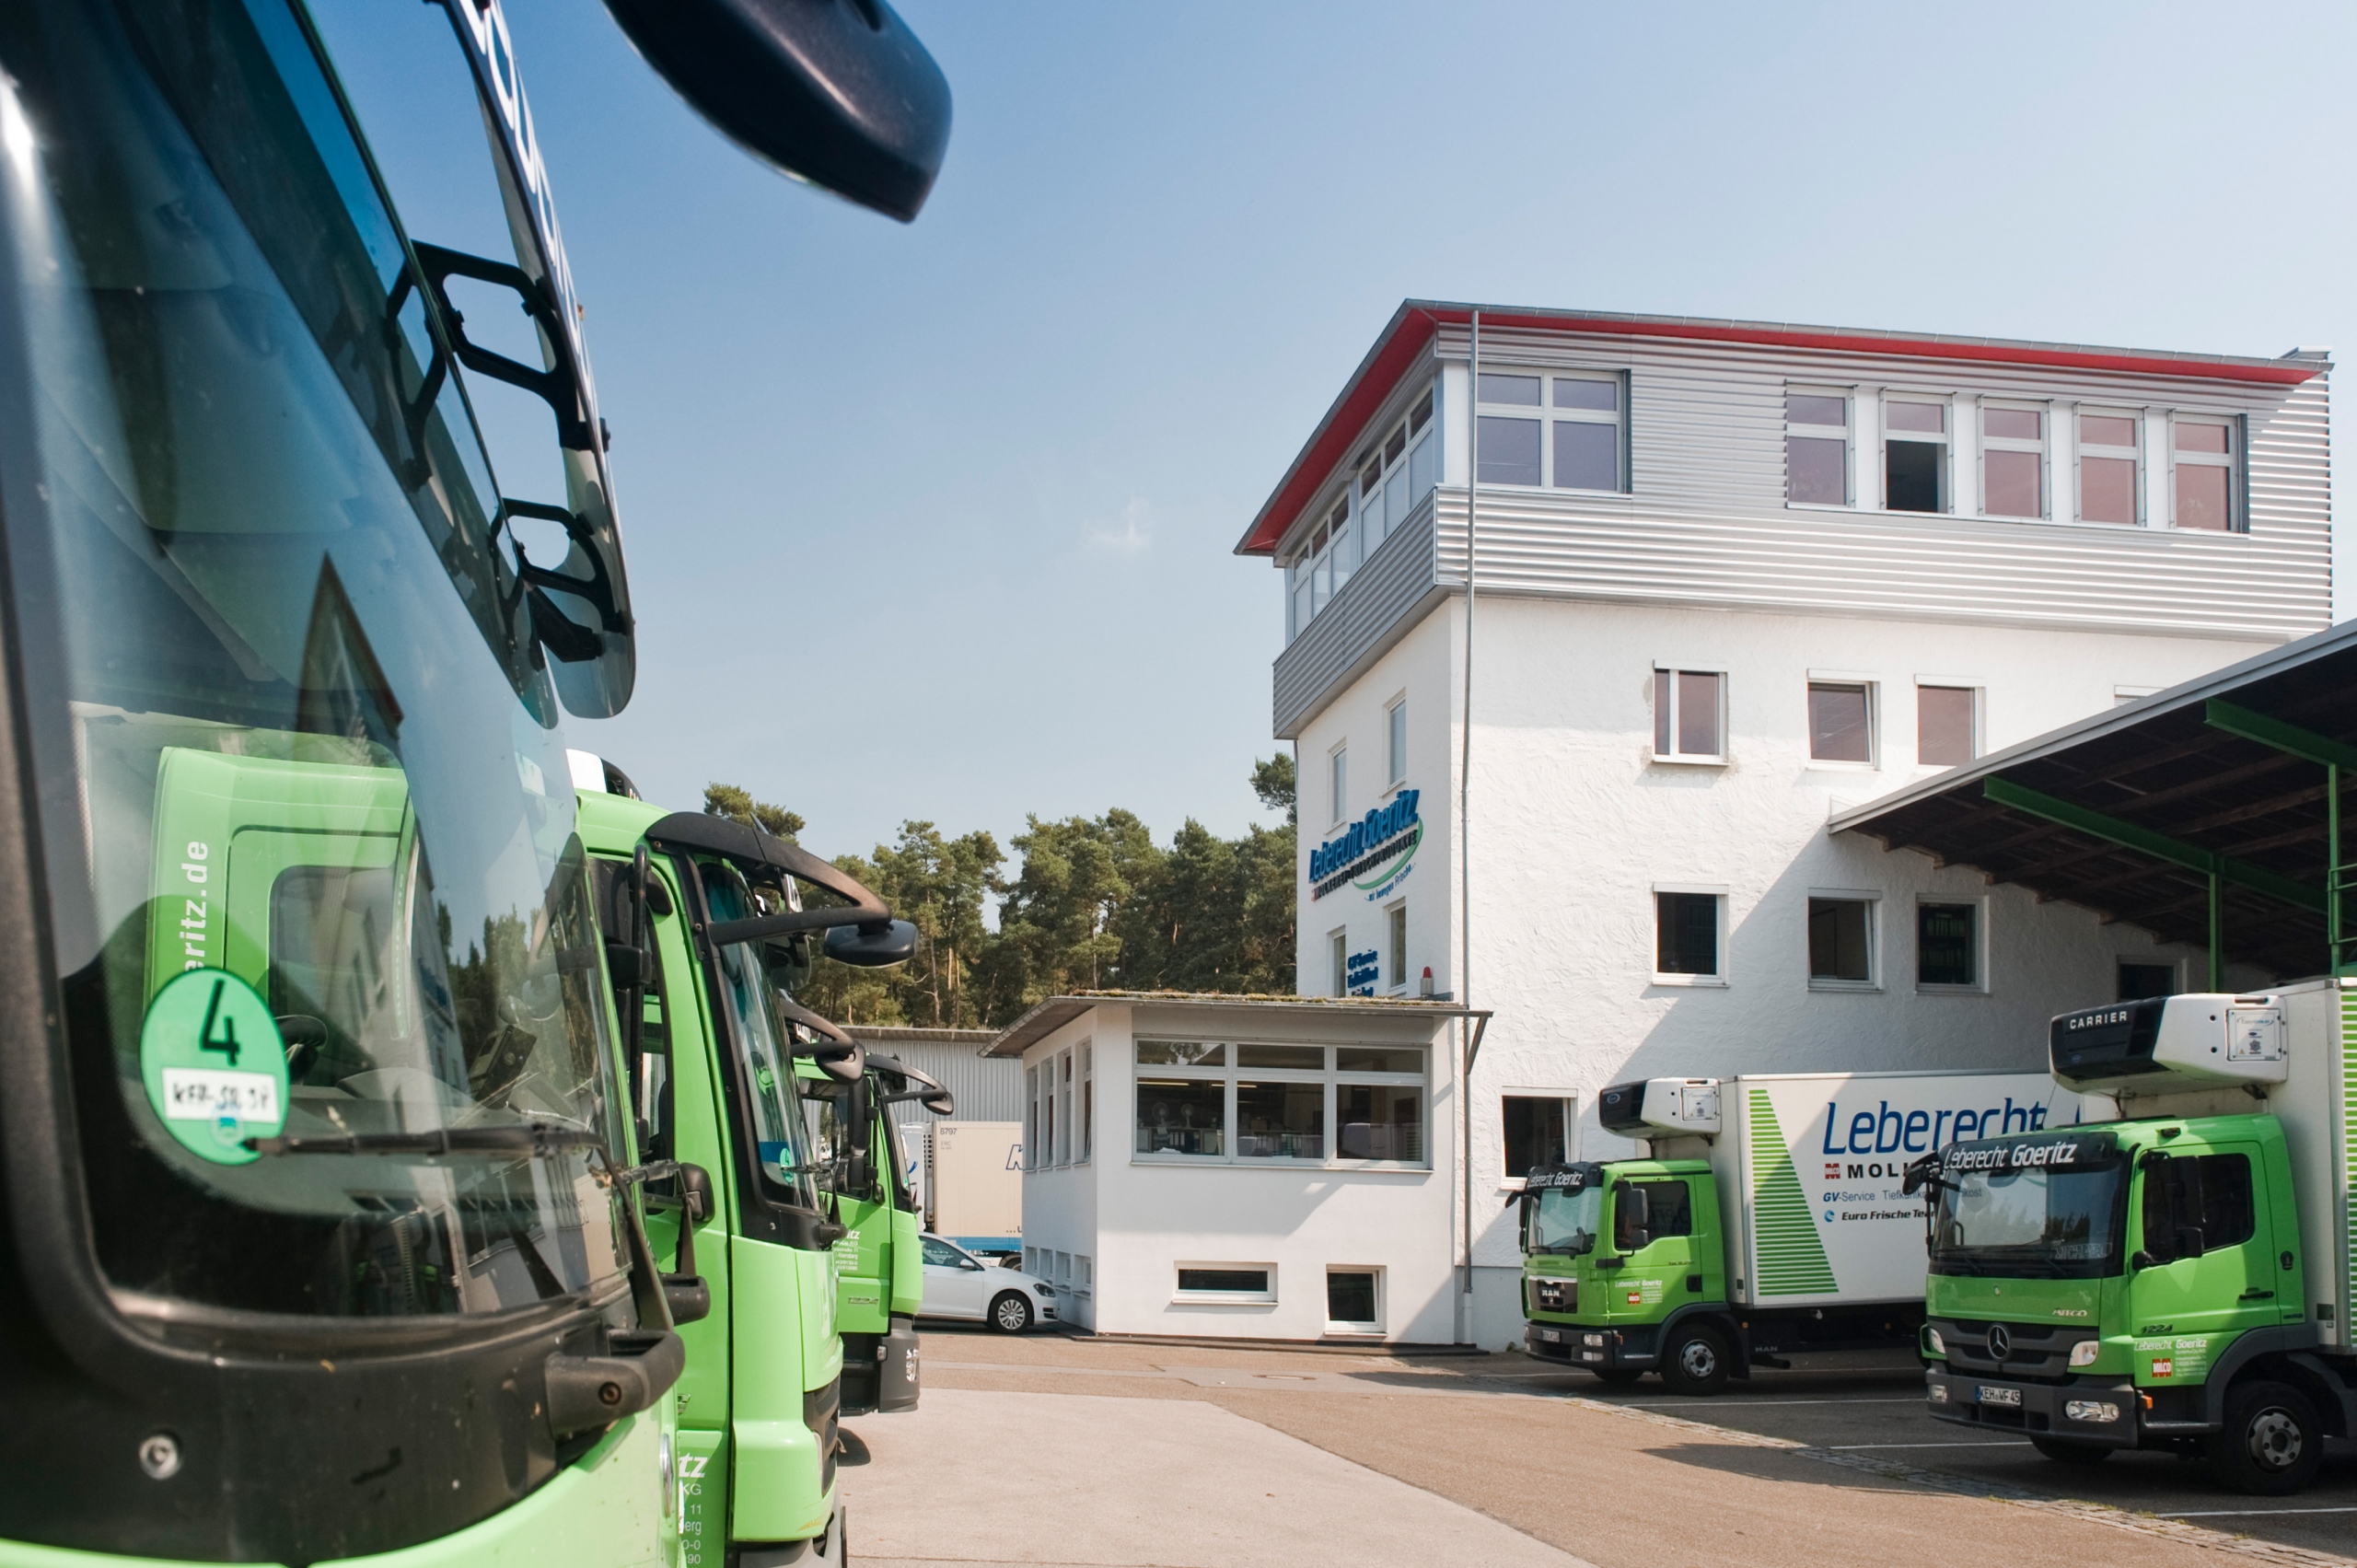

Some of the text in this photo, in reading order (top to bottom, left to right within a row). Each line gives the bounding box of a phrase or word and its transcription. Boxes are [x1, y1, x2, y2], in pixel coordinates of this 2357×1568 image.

[1308, 789, 1420, 883] Leberecht Goeritz
[199, 978, 240, 1066] 4
[2070, 1011, 2128, 1030] CARRIER
[939, 1127, 958, 1135] 8797
[1823, 1098, 2047, 1155] Leberecht
[1944, 1141, 2078, 1169] Leberecht Goeritz
[1527, 1171, 1584, 1188] Leberecht Goeritz
[1823, 1191, 1875, 1202] GV-Service
[1841, 1211, 1867, 1221] Euro
[1870, 1210, 1910, 1220] Frische
[2053, 1243, 2108, 1260] MICHAEL
[1541, 1289, 1560, 1297] MAN
[2141, 1323, 2174, 1334] 1224
[2133, 1338, 2208, 1351] Leberecht Goeritz
[2153, 1363, 2171, 1373] MILCO
[1980, 1388, 2020, 1403] KEH WF 45
[690, 1504, 702, 1516] 11
